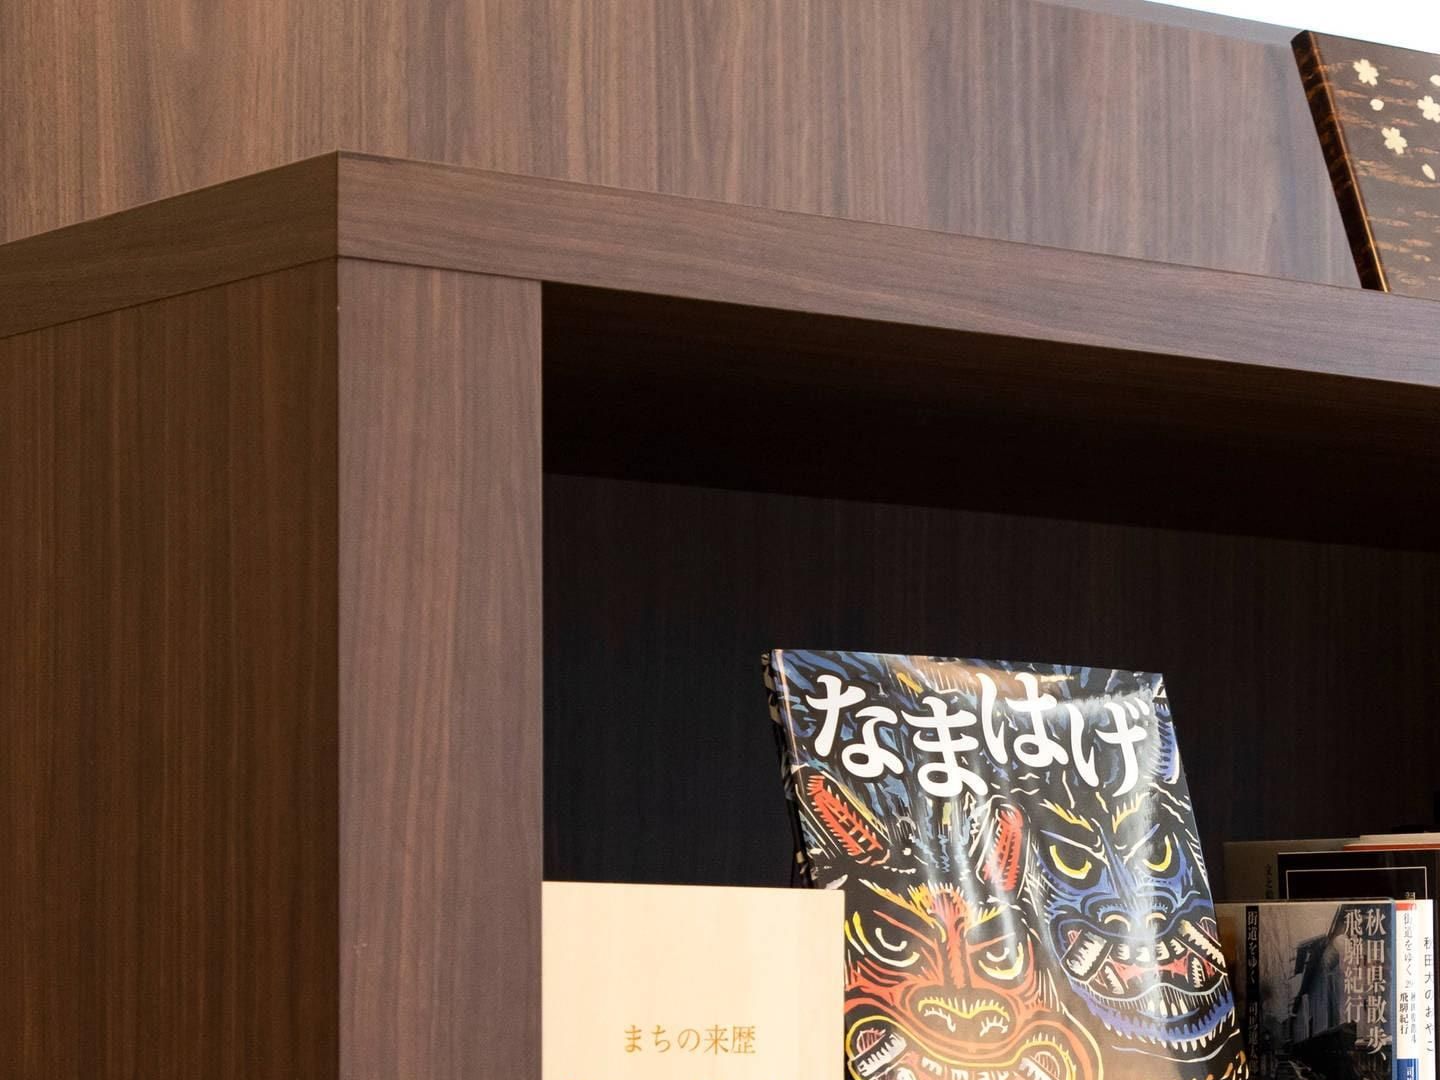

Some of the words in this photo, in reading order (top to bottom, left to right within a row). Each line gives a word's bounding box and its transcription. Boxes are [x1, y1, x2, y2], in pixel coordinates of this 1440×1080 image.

[804, 672, 1151, 797] なまはげ
[1247, 910, 1259, 984] 街道をゆく
[624, 1024, 757, 1055] まちの来歴
